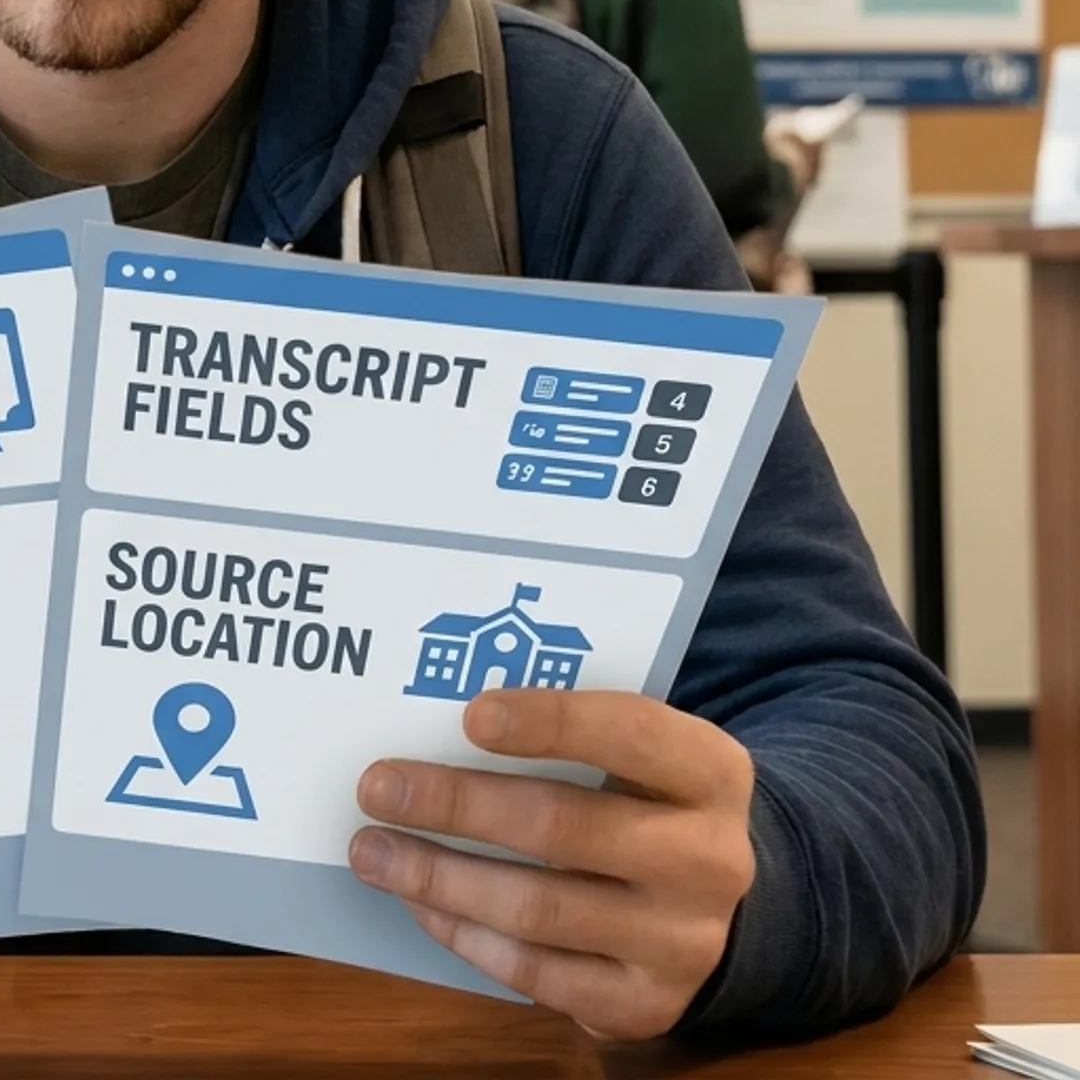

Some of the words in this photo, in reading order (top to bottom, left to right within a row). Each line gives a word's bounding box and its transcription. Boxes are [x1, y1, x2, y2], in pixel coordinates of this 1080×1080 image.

[129, 321, 487, 409] TRANSCRIPT
[123, 381, 313, 451] FIELDS
[669, 391, 687, 412] 4
[654, 434, 673, 455] 5
[640, 476, 658, 498] 6
[105, 541, 330, 614] SOURCE
[100, 599, 373, 678] LOCATION
